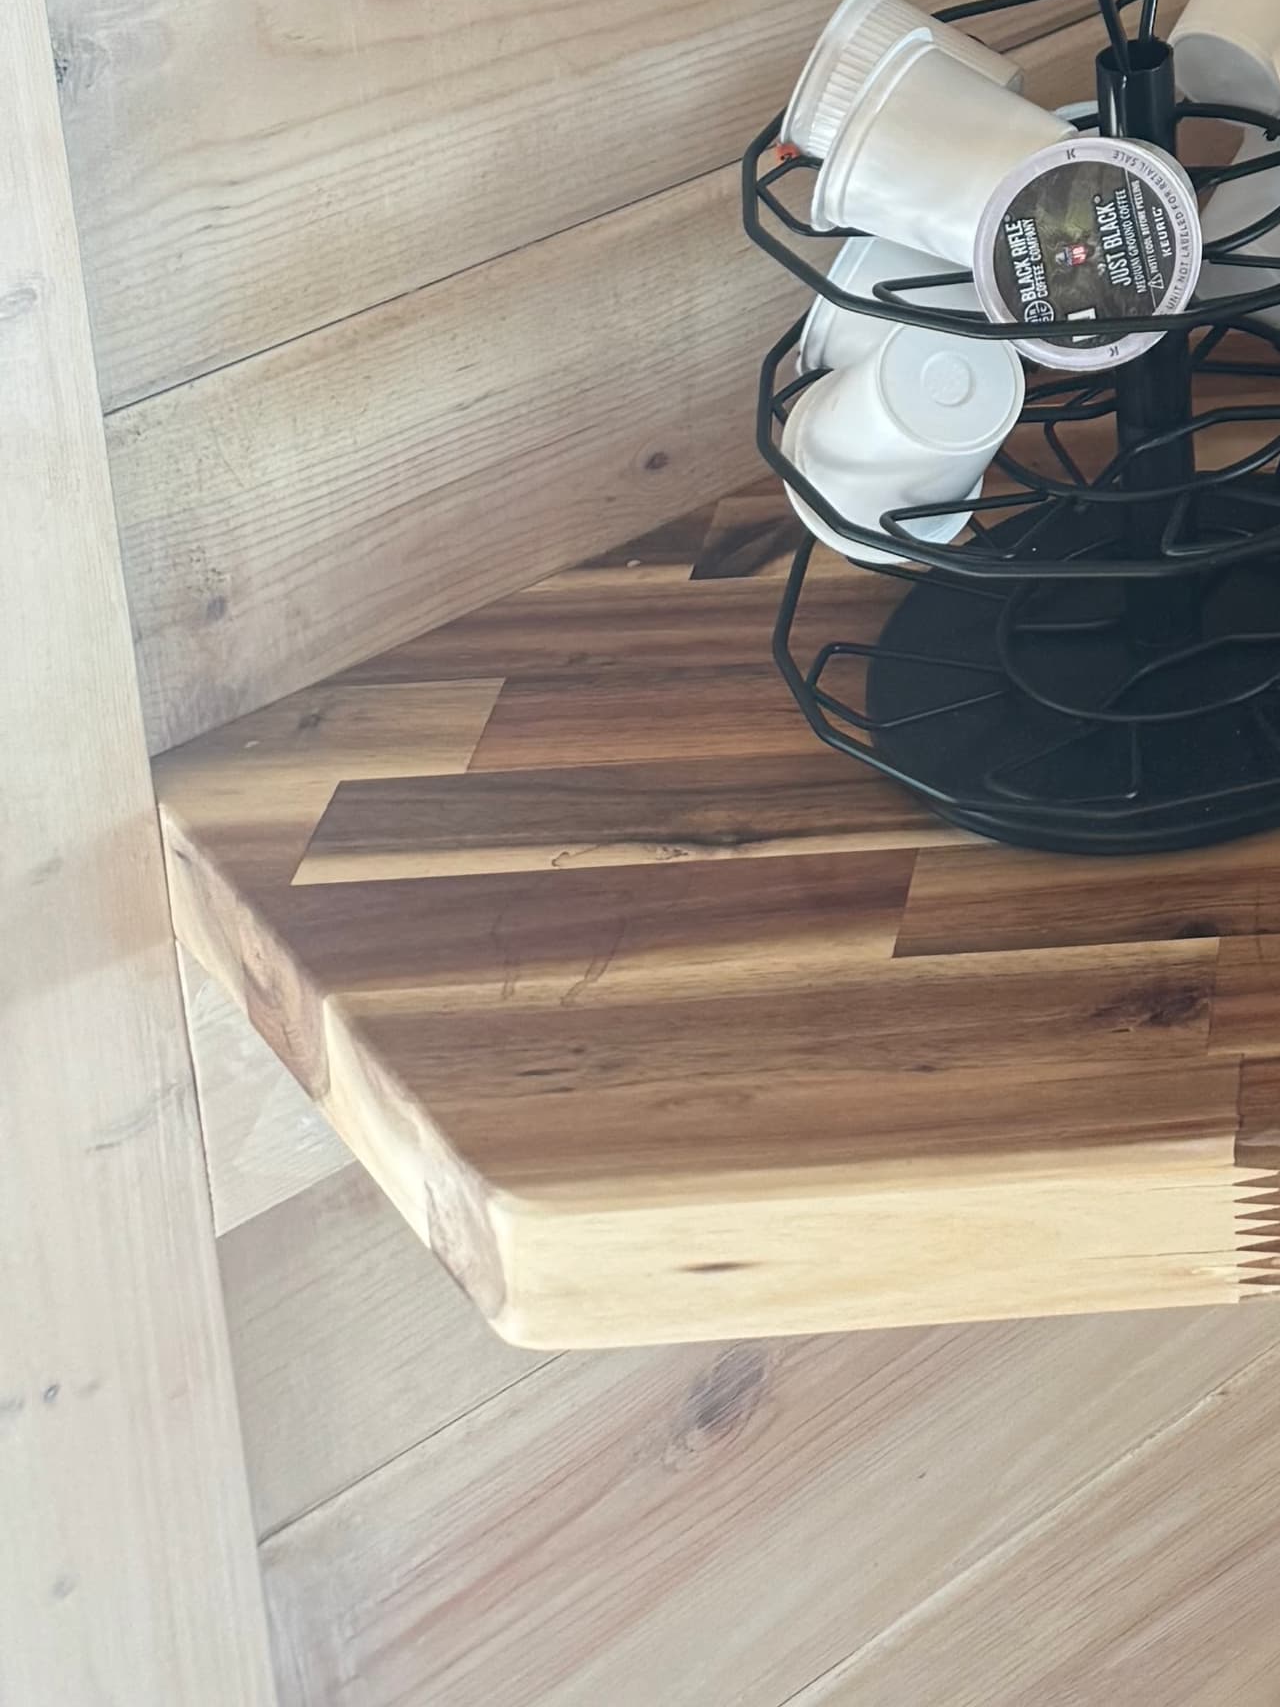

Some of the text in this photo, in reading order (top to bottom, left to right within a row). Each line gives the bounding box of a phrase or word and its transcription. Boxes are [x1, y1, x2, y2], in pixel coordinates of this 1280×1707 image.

[1005, 219, 1037, 302] BLACK RIFLE
[1022, 218, 1042, 261] COMPANY
[1095, 202, 1132, 286] JUST BLACK
[1112, 149, 1191, 309] UNIT NOT LABELED FOR RETAIL SALE
[1115, 189, 1147, 293] MEDIUM GROUND COFFEE
[1152, 206, 1173, 258] KEURIG
[1032, 262, 1049, 298] COFFEE
